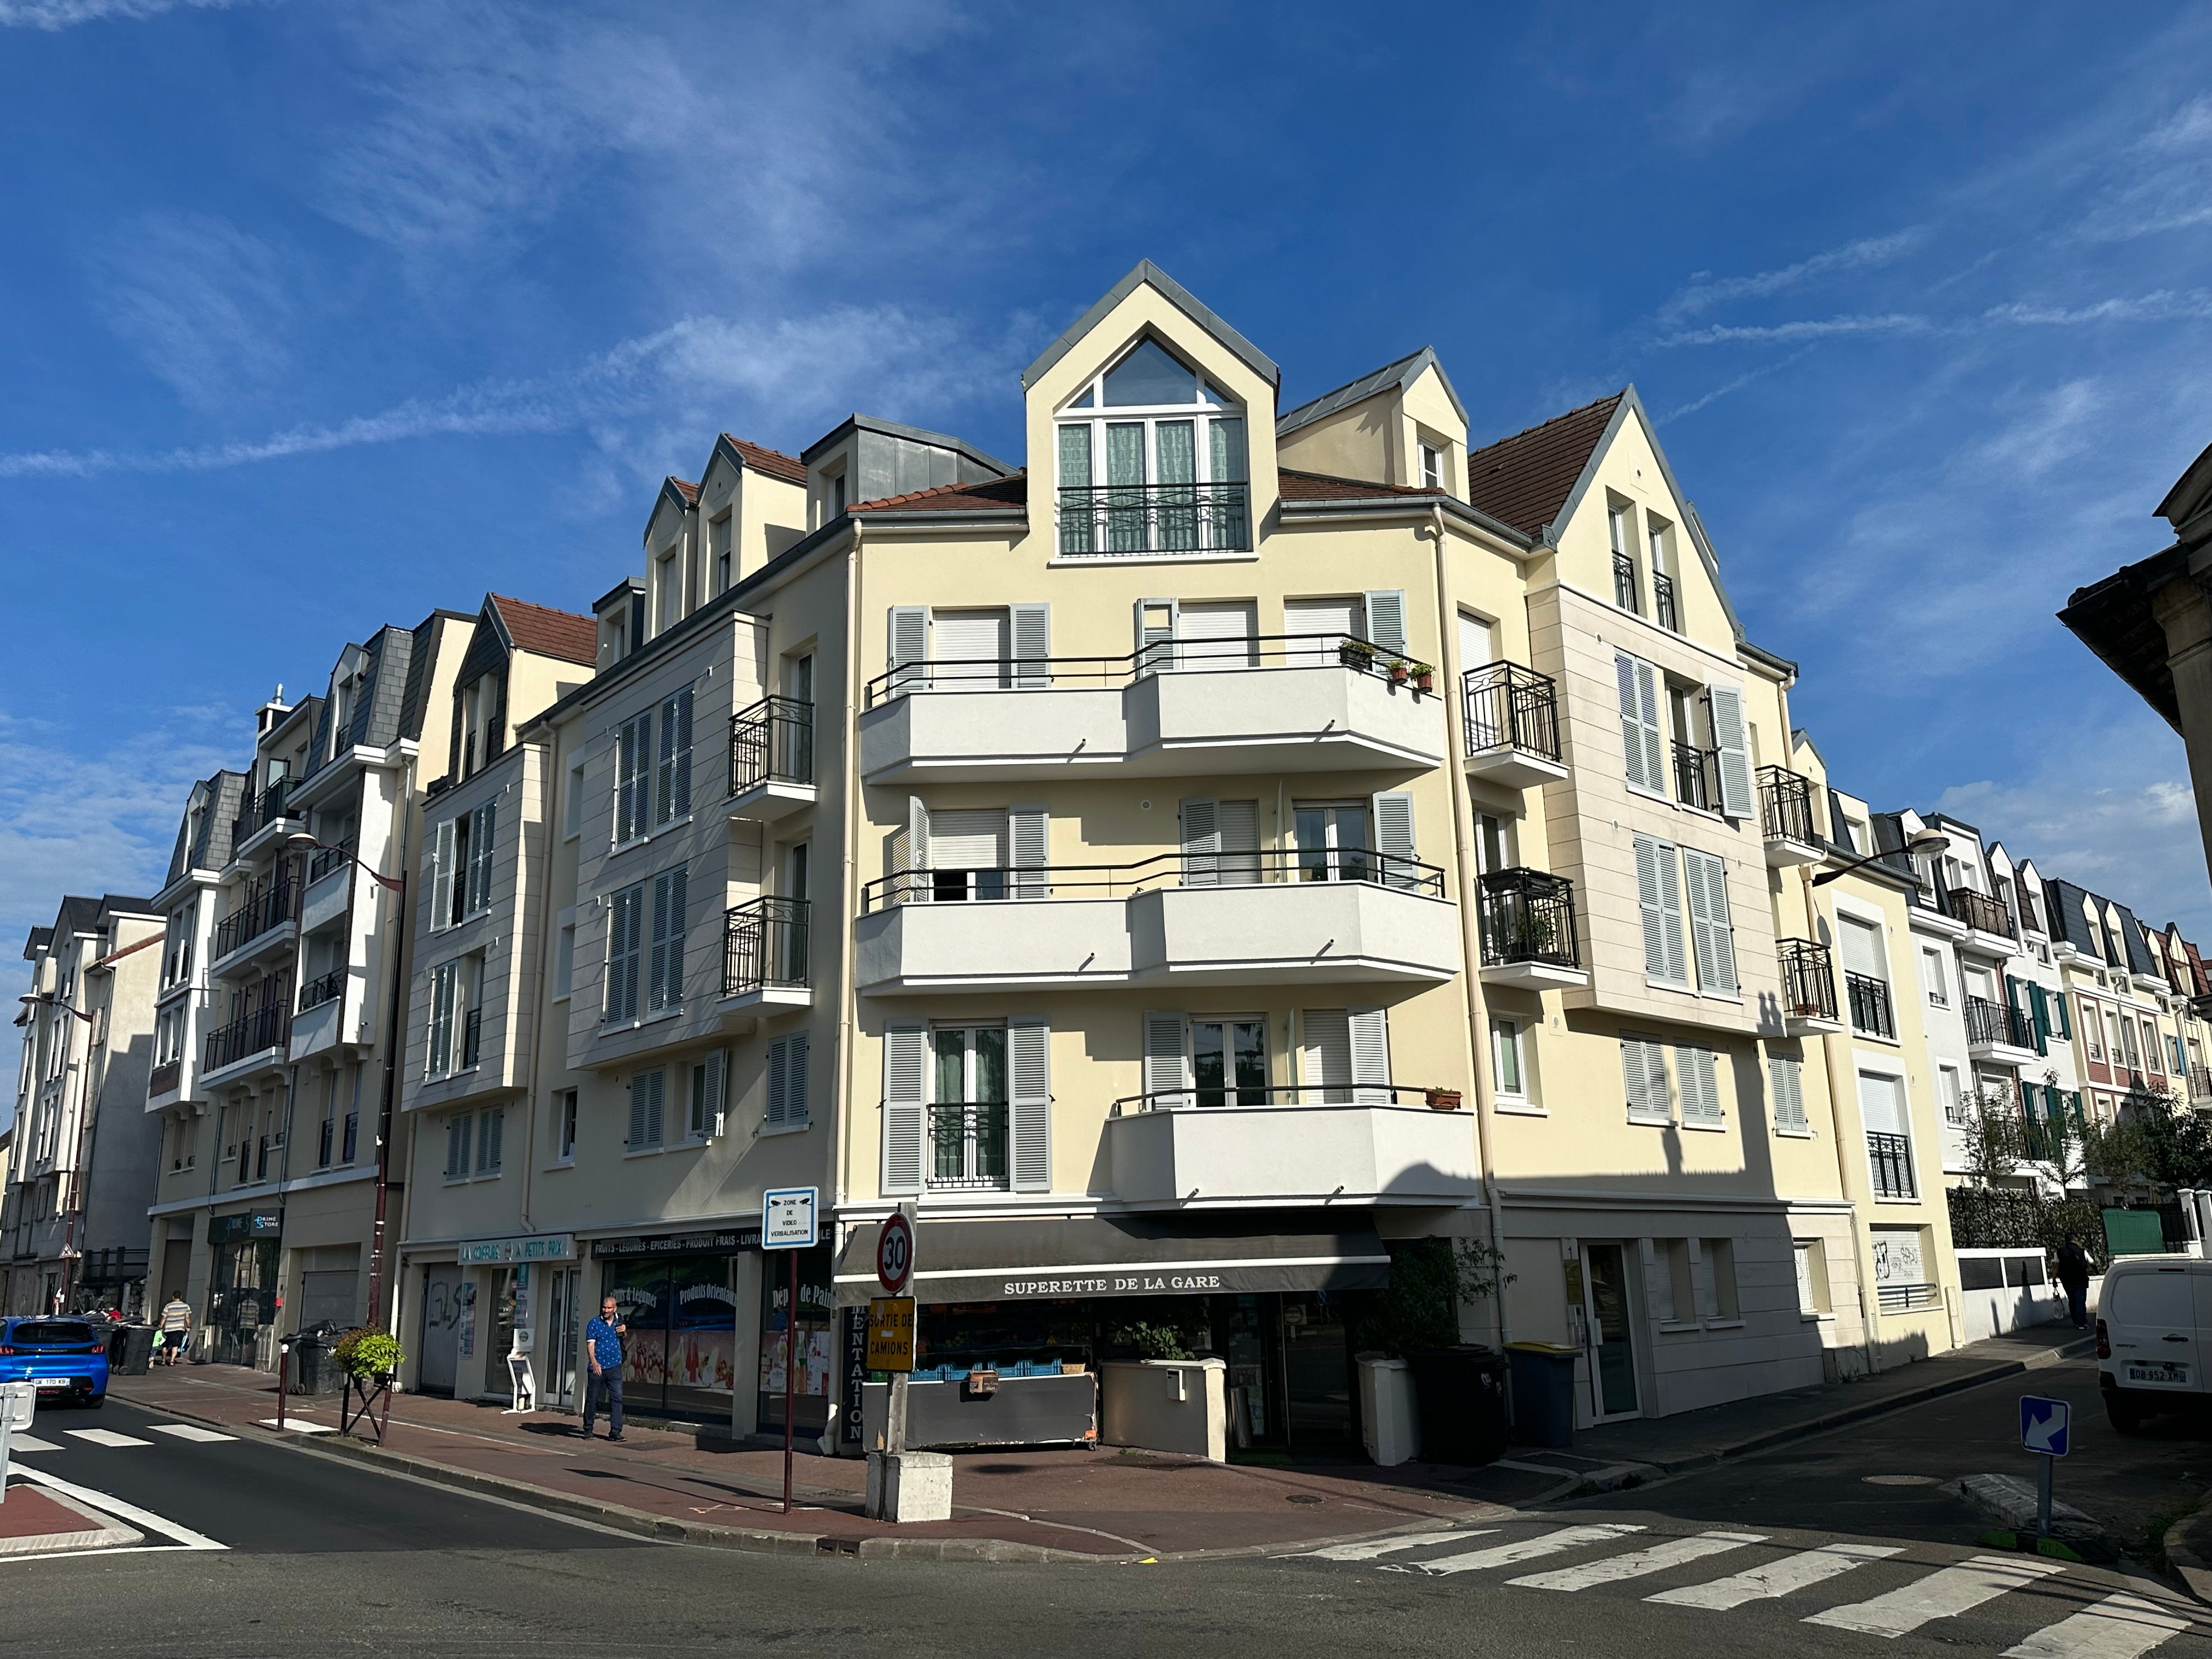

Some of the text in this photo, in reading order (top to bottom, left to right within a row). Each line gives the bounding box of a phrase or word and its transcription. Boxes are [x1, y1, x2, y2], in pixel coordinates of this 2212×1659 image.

[525, 1241, 545, 1257] PETITS
[549, 1239, 563, 1256] PRIX
[595, 1243, 615, 1254] FRUITS
[650, 1239, 681, 1251] EPICERIES
[686, 1237, 714, 1249] PRODUIT
[715, 1235, 735, 1246] FRAIS
[884, 1236, 905, 1271] 30
[680, 1283, 706, 1305] Produits
[1005, 1276, 1220, 1295] SUPERETTE DE LA GARE
[772, 1286, 788, 1308] Dép
[800, 1284, 811, 1303] de
[870, 1313, 912, 1328] SORTIE DE
[870, 1341, 909, 1355] CAMIONS
